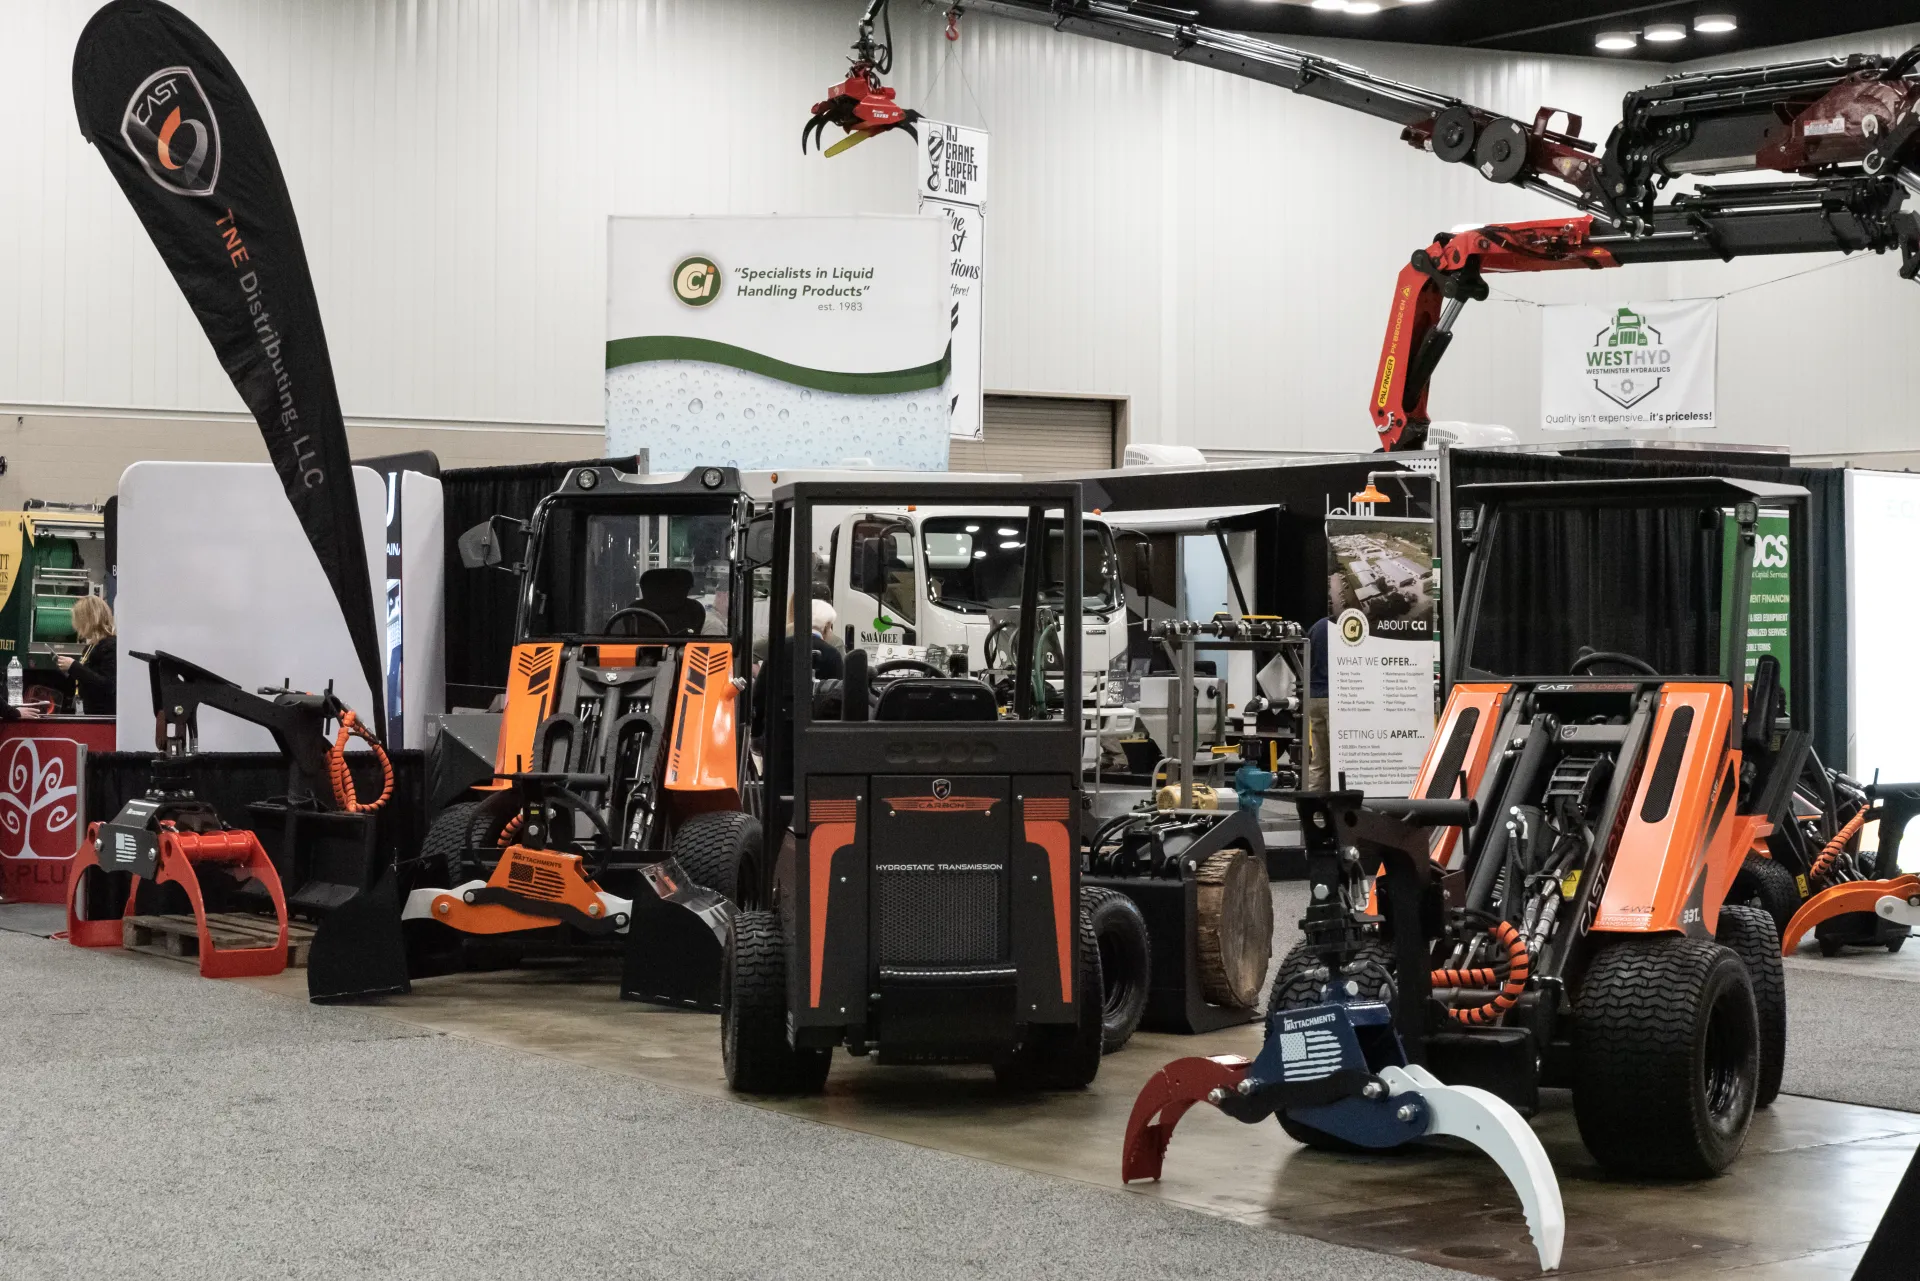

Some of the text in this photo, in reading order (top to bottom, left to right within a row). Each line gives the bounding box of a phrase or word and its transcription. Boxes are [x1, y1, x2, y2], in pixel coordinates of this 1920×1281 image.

[136, 78, 178, 126] CAST
[946, 125, 958, 142] NJ
[946, 142, 974, 164] CRANE
[945, 160, 978, 182] EXPERT
[945, 178, 966, 196] .COM
[816, 268, 828, 279] in
[832, 267, 874, 282] Liquid
[737, 285, 798, 300] Handling
[818, 302, 863, 311] est. 1983
[216, 208, 324, 488] TNE Distributing, LLC
[1586, 350, 1670, 366] WESTHYD
[1379, 358, 1394, 404] PALFINGER
[1546, 414, 1576, 424] Quality
[1665, 412, 1712, 424] priceless!
[1377, 620, 1427, 630] ABOUT CCI
[1768, 628, 1787, 636] SERVICE
[1337, 656, 1417, 666] WHAT WE OFFER...
[1338, 730, 1425, 739] SETTING US APART...
